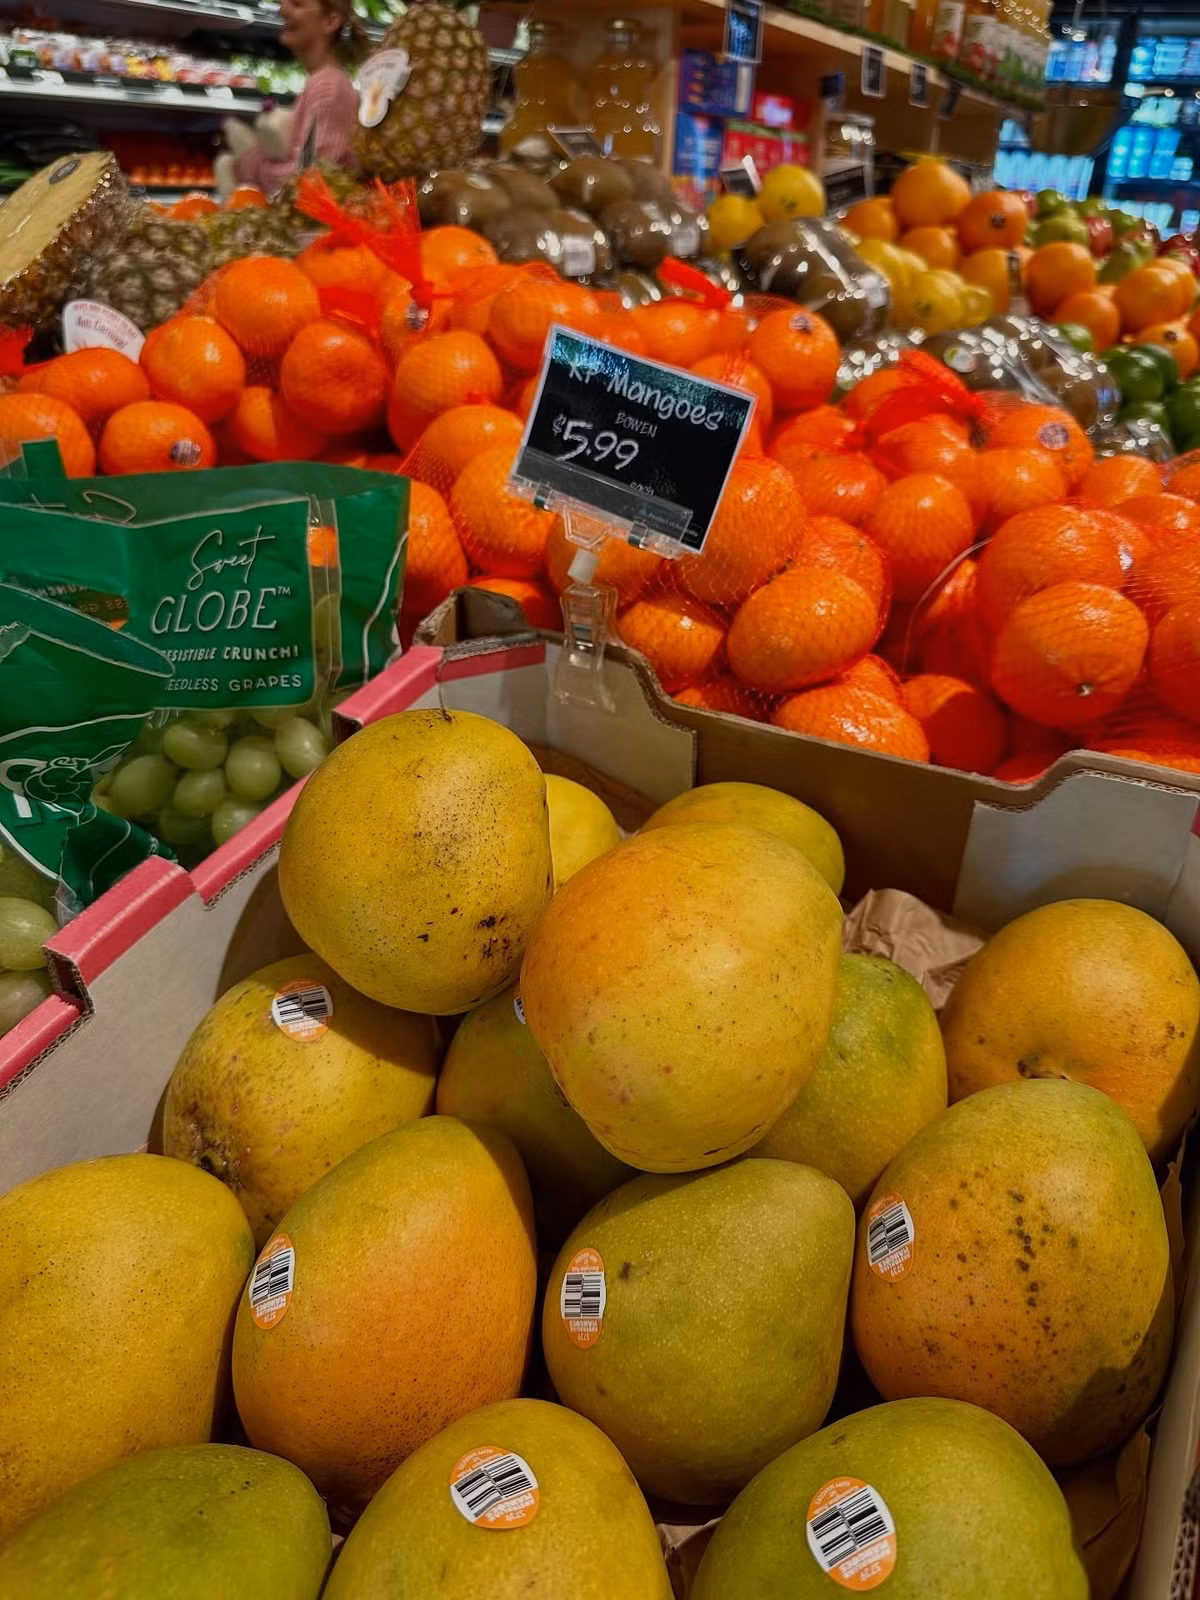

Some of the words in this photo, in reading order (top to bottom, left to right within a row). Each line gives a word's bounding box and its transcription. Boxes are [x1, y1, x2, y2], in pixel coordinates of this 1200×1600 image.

[606, 372, 724, 431] Mangoes
[551, 412, 640, 471] $5.99
[614, 410, 659, 438] BOWEN
[186, 525, 277, 591] Sweet
[223, 645, 300, 661] CRUNCH!
[165, 678, 219, 692] EEDLESS
[229, 675, 302, 692] GRAPES
